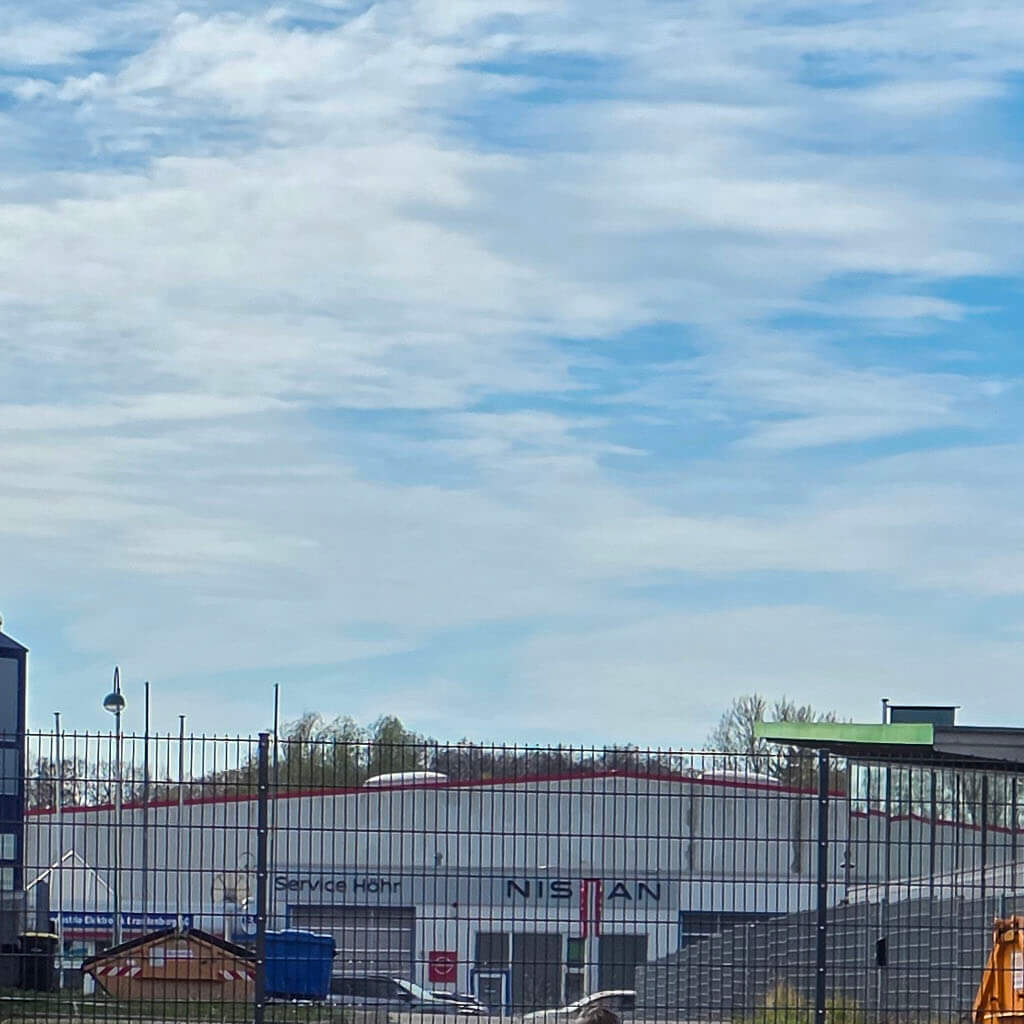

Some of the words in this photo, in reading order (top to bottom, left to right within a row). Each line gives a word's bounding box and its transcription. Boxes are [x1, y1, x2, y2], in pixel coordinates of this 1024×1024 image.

[274, 876, 347, 892] Service
[353, 877, 401, 893] Höhr
[507, 880, 661, 901] NISAN
